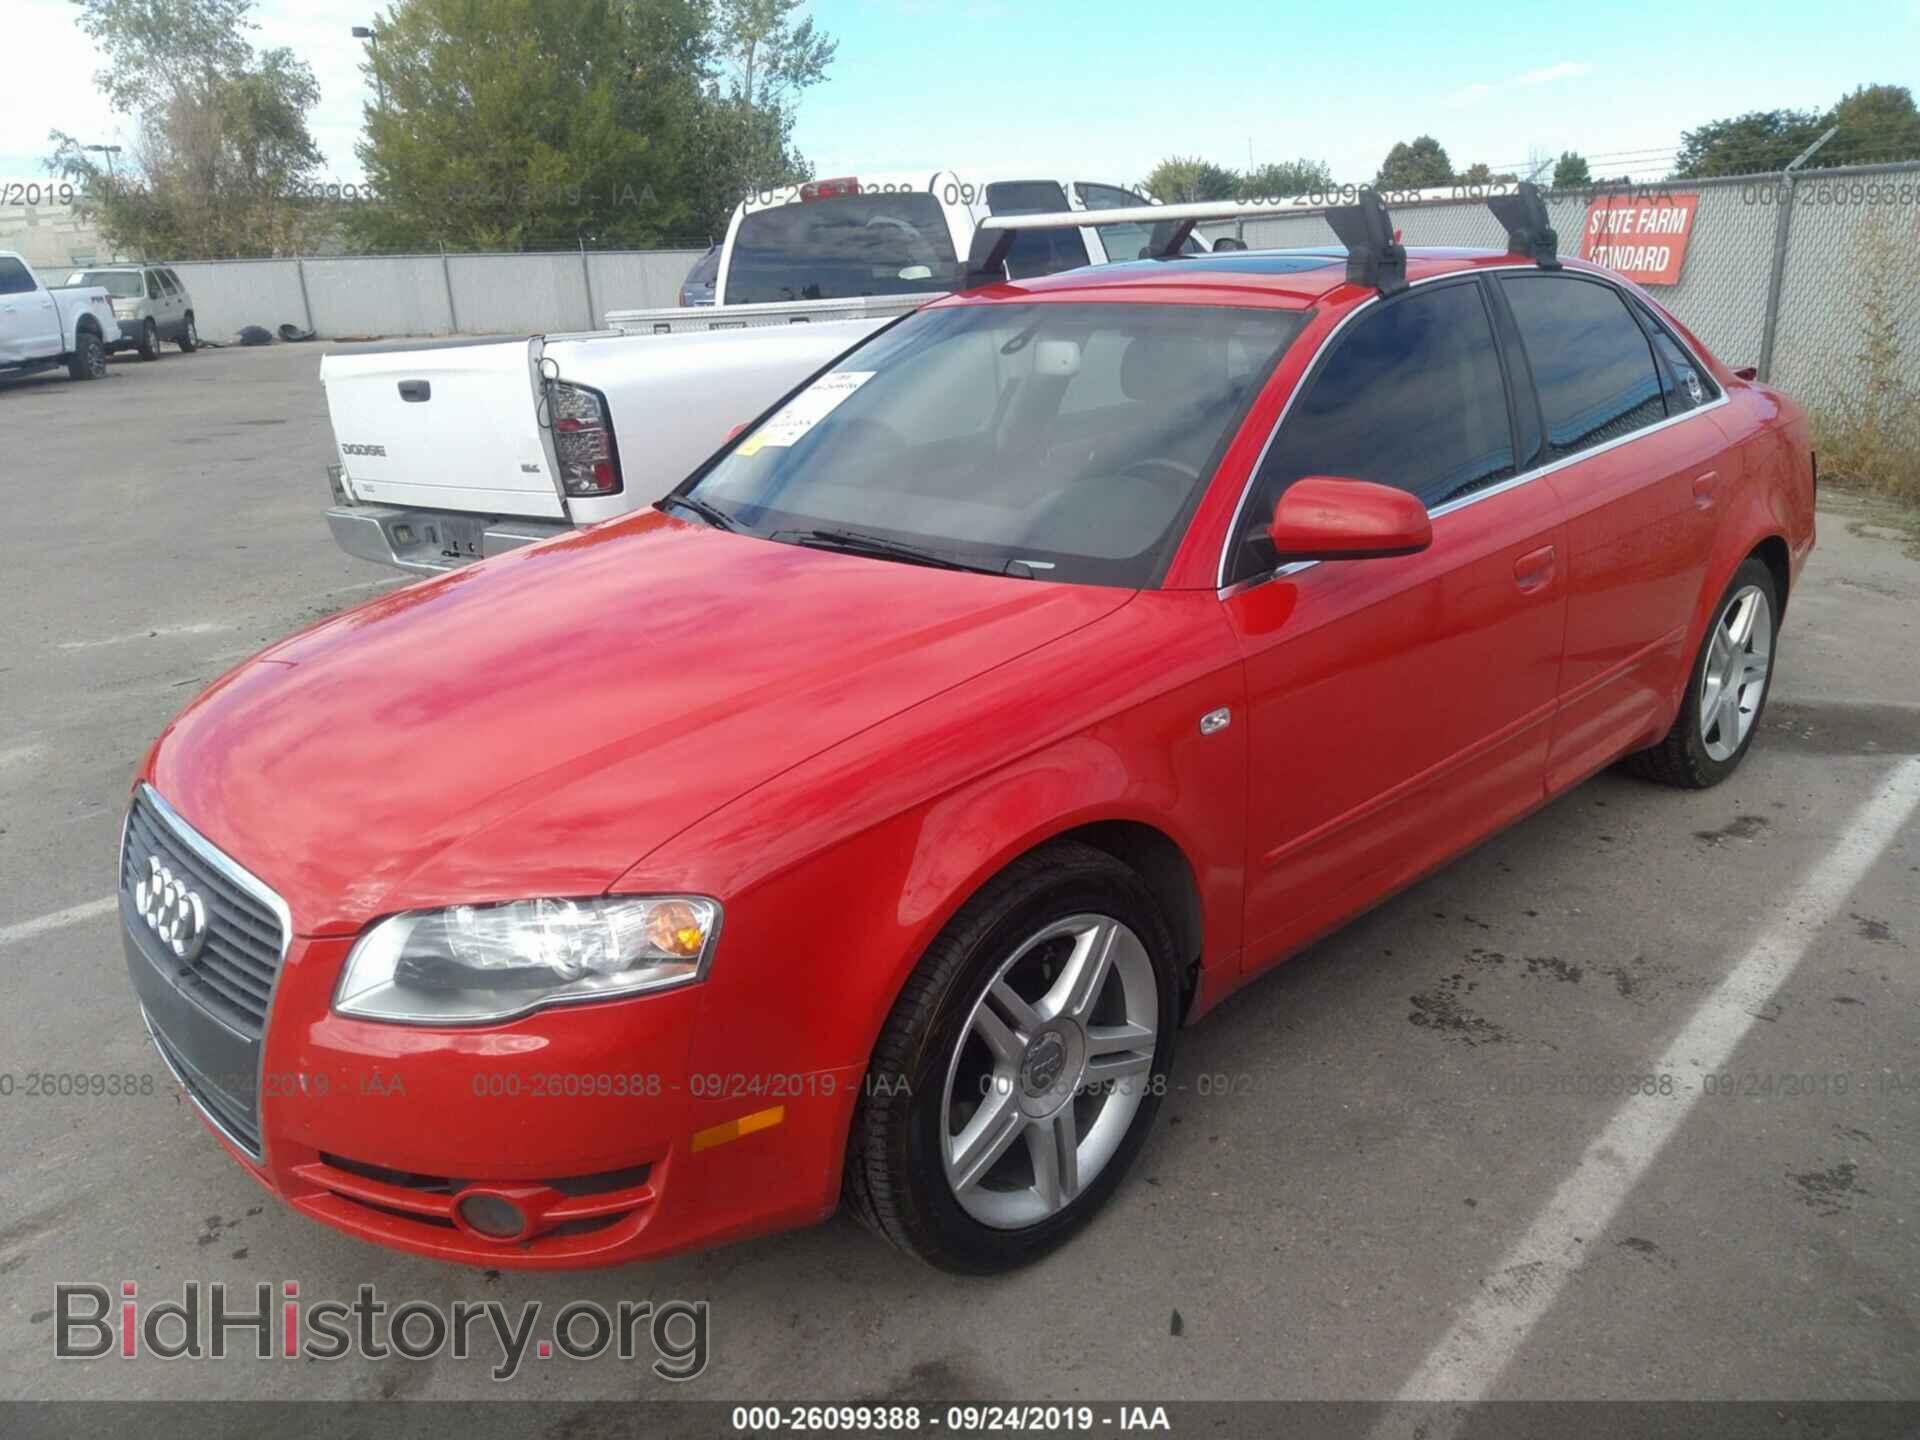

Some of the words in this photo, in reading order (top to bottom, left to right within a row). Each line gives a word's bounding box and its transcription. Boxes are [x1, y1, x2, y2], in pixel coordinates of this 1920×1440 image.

[1590, 207, 1637, 235] STATE
[1635, 207, 1689, 235] FARM
[1588, 245, 1671, 272] STANDARD
